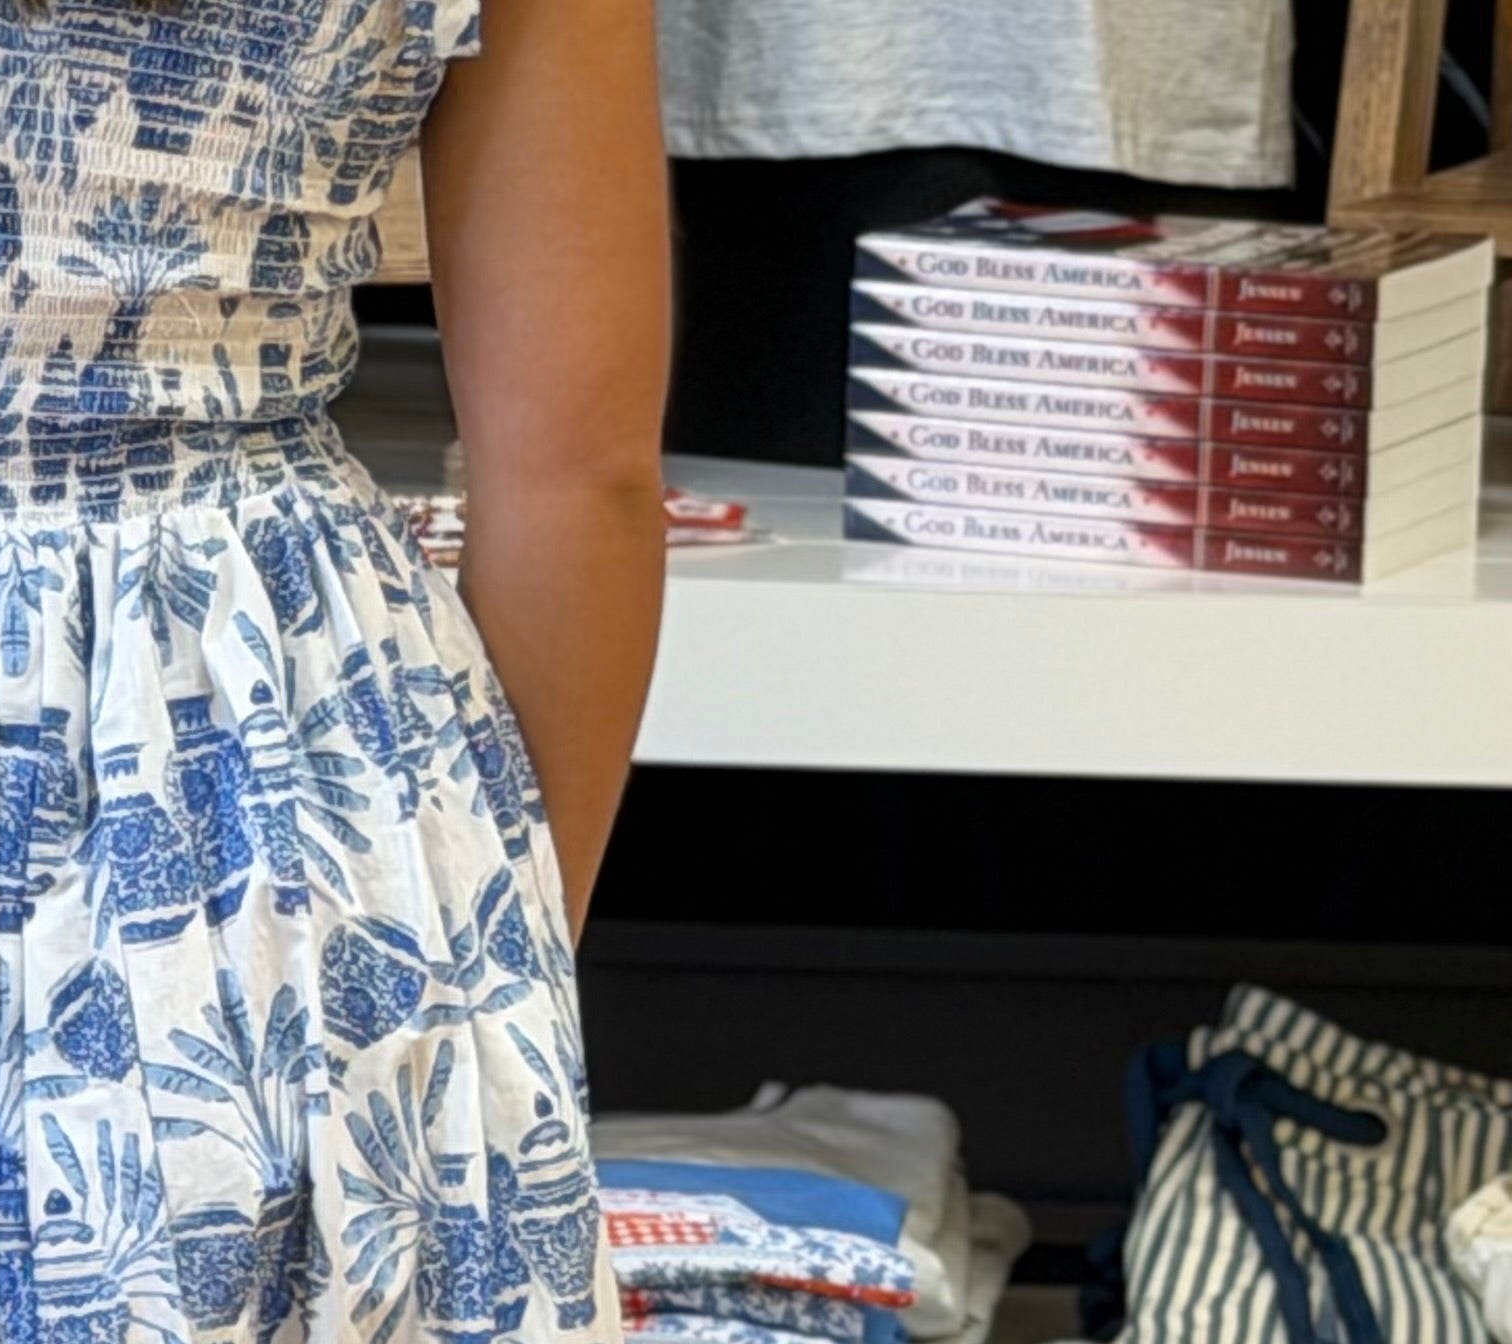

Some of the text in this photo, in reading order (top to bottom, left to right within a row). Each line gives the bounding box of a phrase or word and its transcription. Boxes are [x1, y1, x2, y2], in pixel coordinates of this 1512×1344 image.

[916, 252, 1142, 290] GOD BLESS AMERICA
[911, 295, 1138, 333] GOD BLESS AMERICA
[911, 338, 1138, 376] GOD BLESS AMERICA
[908, 382, 1136, 420] GOD BLESS AMERICA
[908, 425, 1134, 464] GOD BLESS AMERICA
[907, 468, 1132, 508] GOD BLESS AMERICA
[904, 511, 1129, 551] GOD BLESS AMERICA
